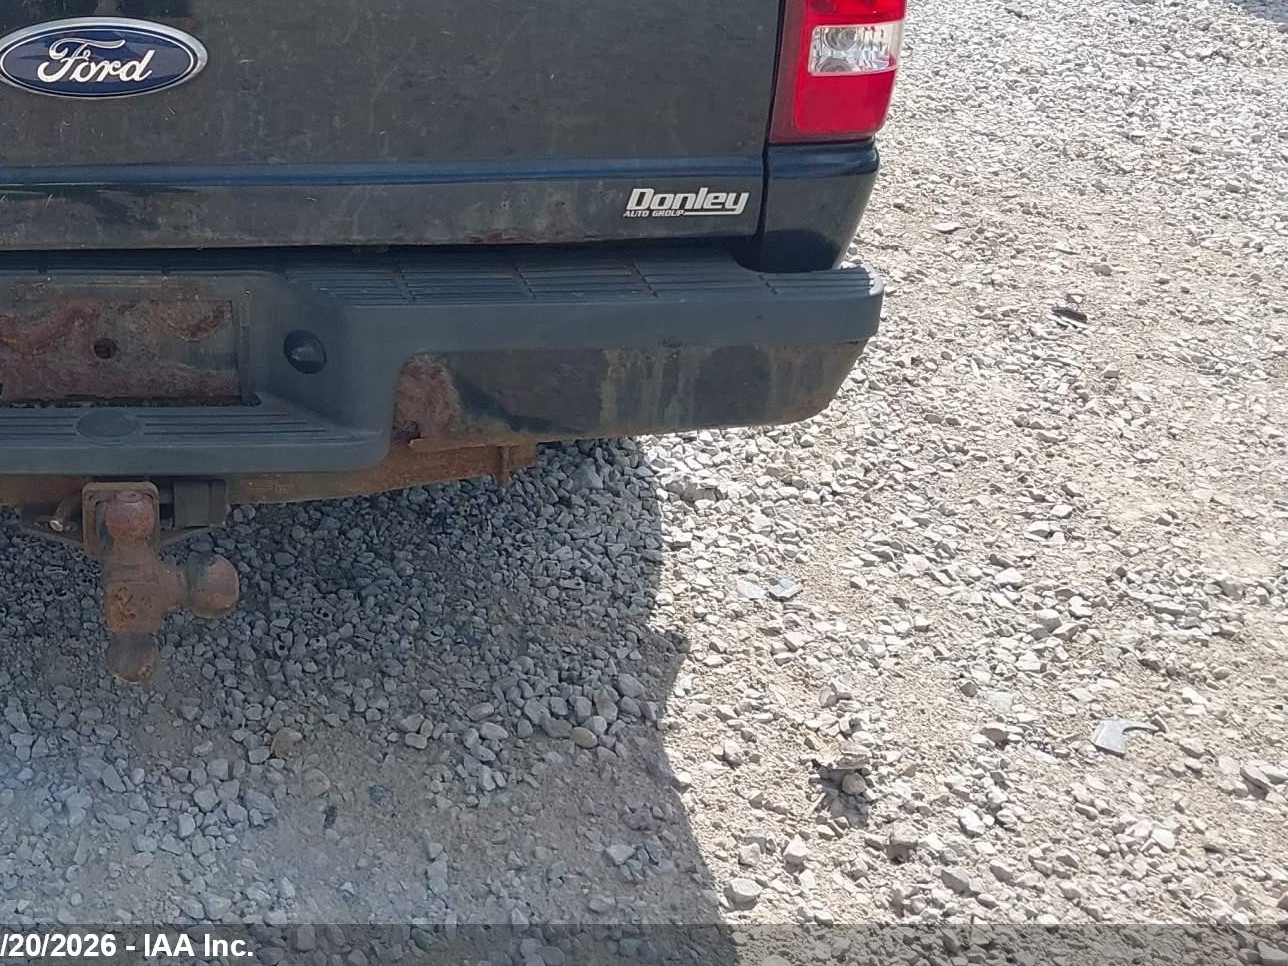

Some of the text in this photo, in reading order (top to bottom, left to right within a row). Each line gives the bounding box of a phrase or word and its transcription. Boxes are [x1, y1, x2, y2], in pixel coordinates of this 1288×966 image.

[37, 37, 156, 83] Ford
[623, 209, 685, 218] AUTO GROUP
[626, 187, 750, 215] Donley
